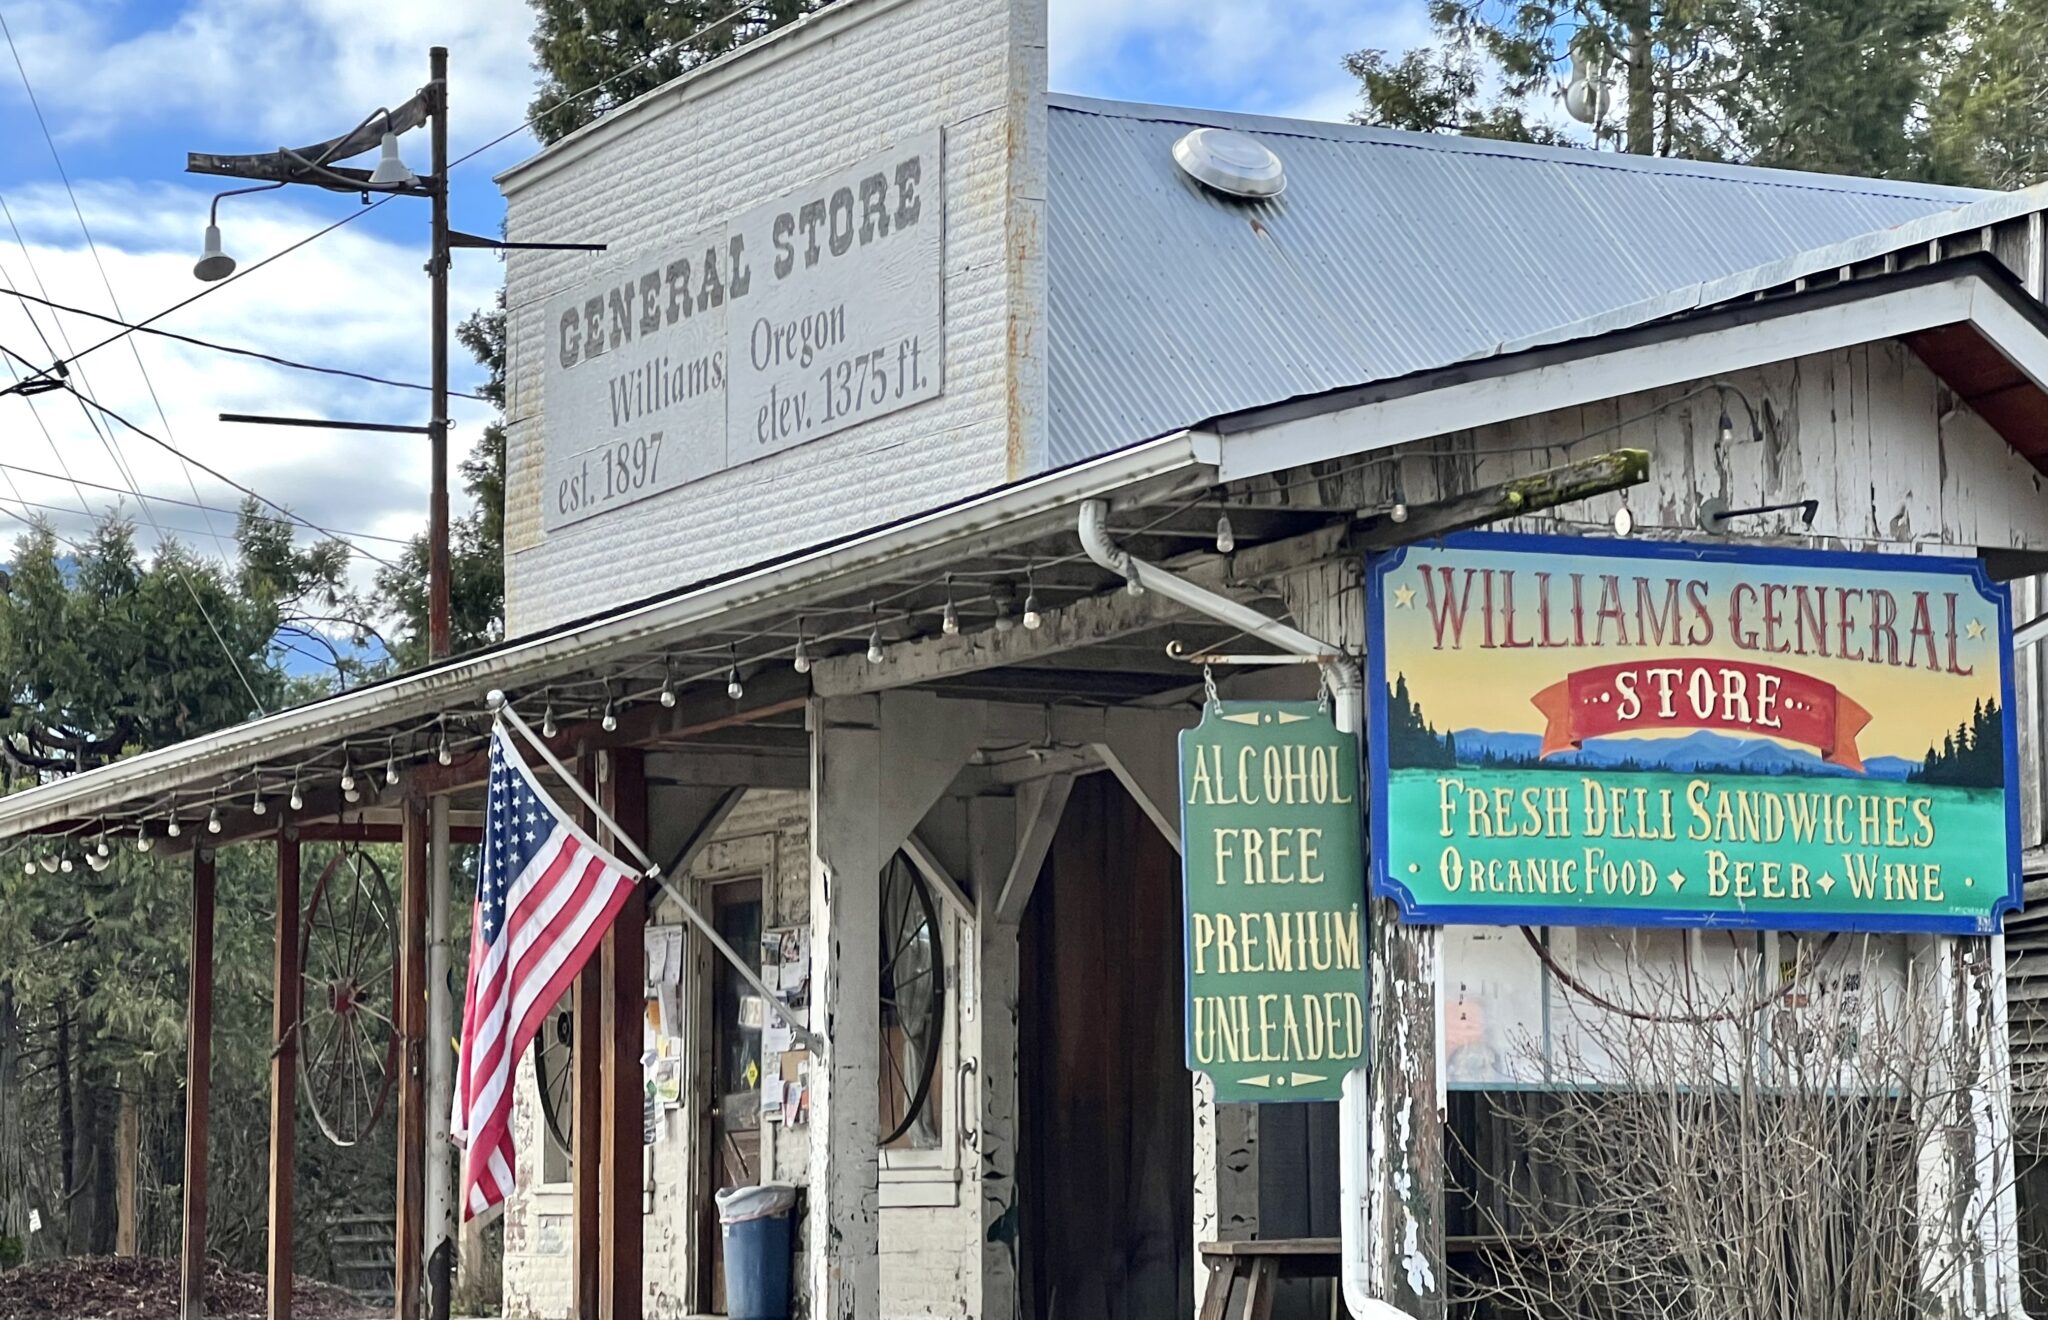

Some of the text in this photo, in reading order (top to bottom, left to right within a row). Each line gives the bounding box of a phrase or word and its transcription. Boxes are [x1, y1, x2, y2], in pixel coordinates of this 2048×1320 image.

[558, 156, 921, 370] GENERAL STORE
[750, 304, 846, 372] Oregon
[757, 335, 928, 444] elev. 1375 ft.
[558, 431, 664, 515] est. 1897
[1416, 563, 1974, 677] WILLIAMS GENERAL
[1614, 667, 1783, 729] STORE
[1187, 744, 1352, 806] ALCOHOL
[1213, 827, 1324, 886] FREE
[1192, 910, 1361, 975] PREMIUM
[1193, 991, 1364, 1064] UNLEADED
